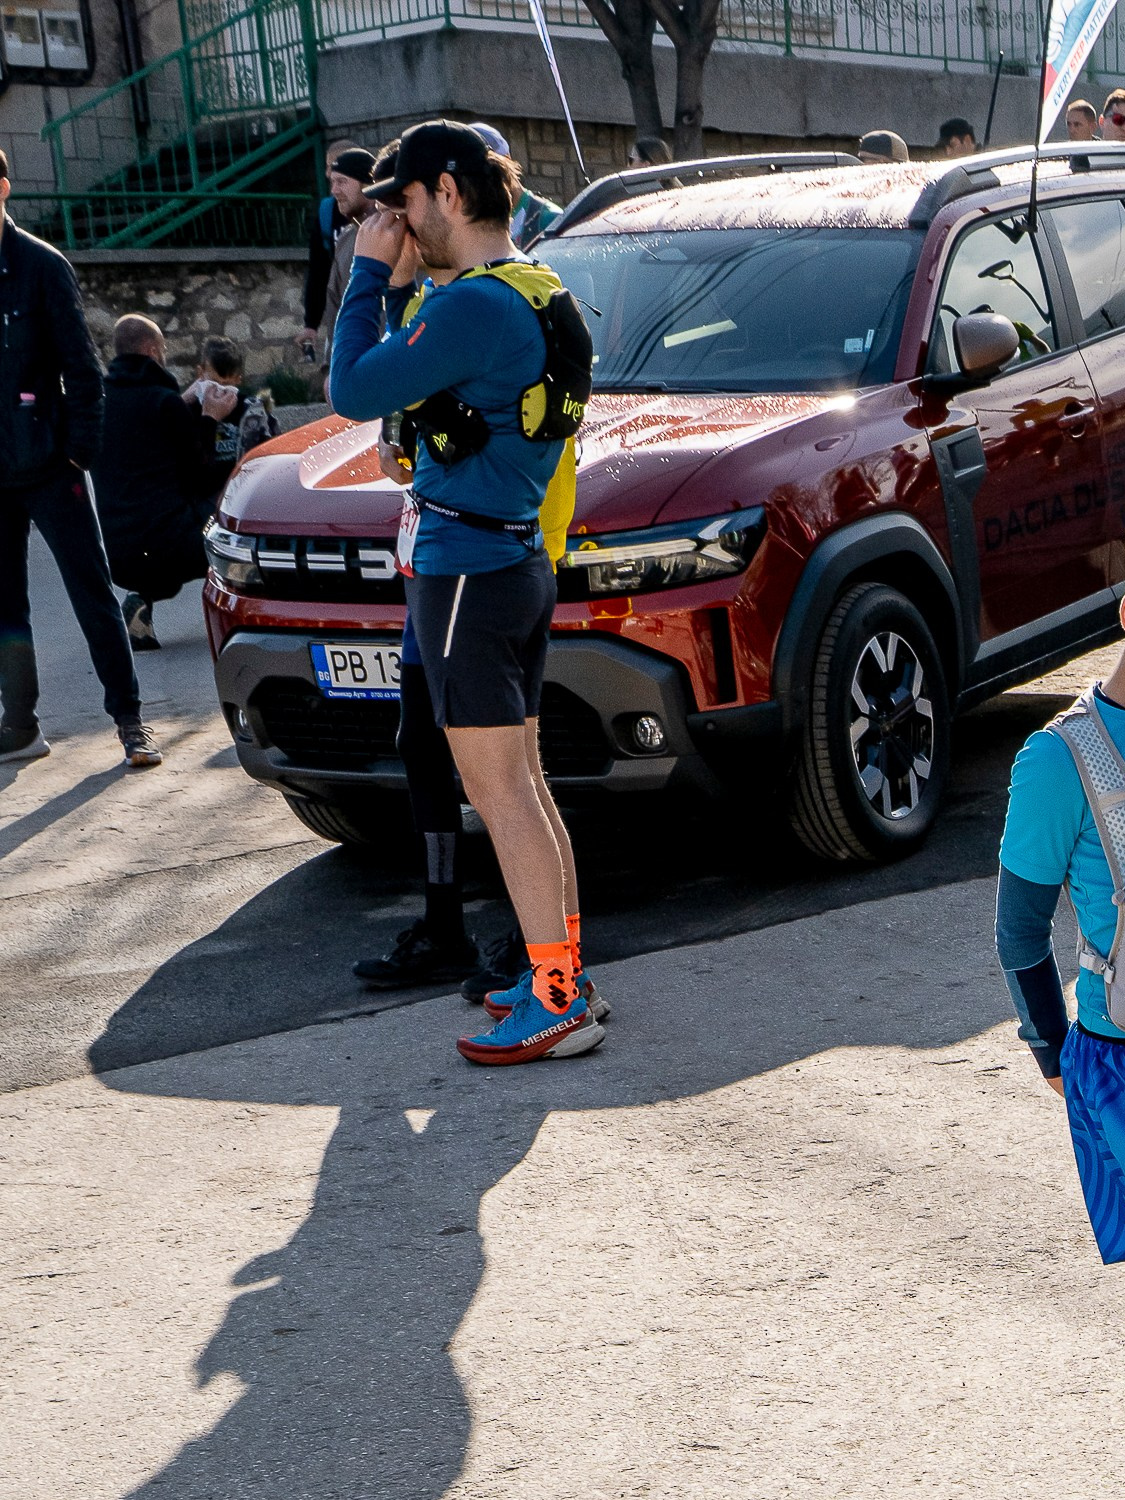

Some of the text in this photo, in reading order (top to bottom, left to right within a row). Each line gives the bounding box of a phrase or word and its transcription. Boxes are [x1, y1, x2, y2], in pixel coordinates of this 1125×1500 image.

[1053, 67, 1072, 106] EVERY
[1070, 40, 1085, 71] STEP
[984, 494, 1068, 551] DACIA
[318, 670, 331, 681] BG
[330, 650, 401, 684] PB 13
[521, 1017, 580, 1048] MERRELL
